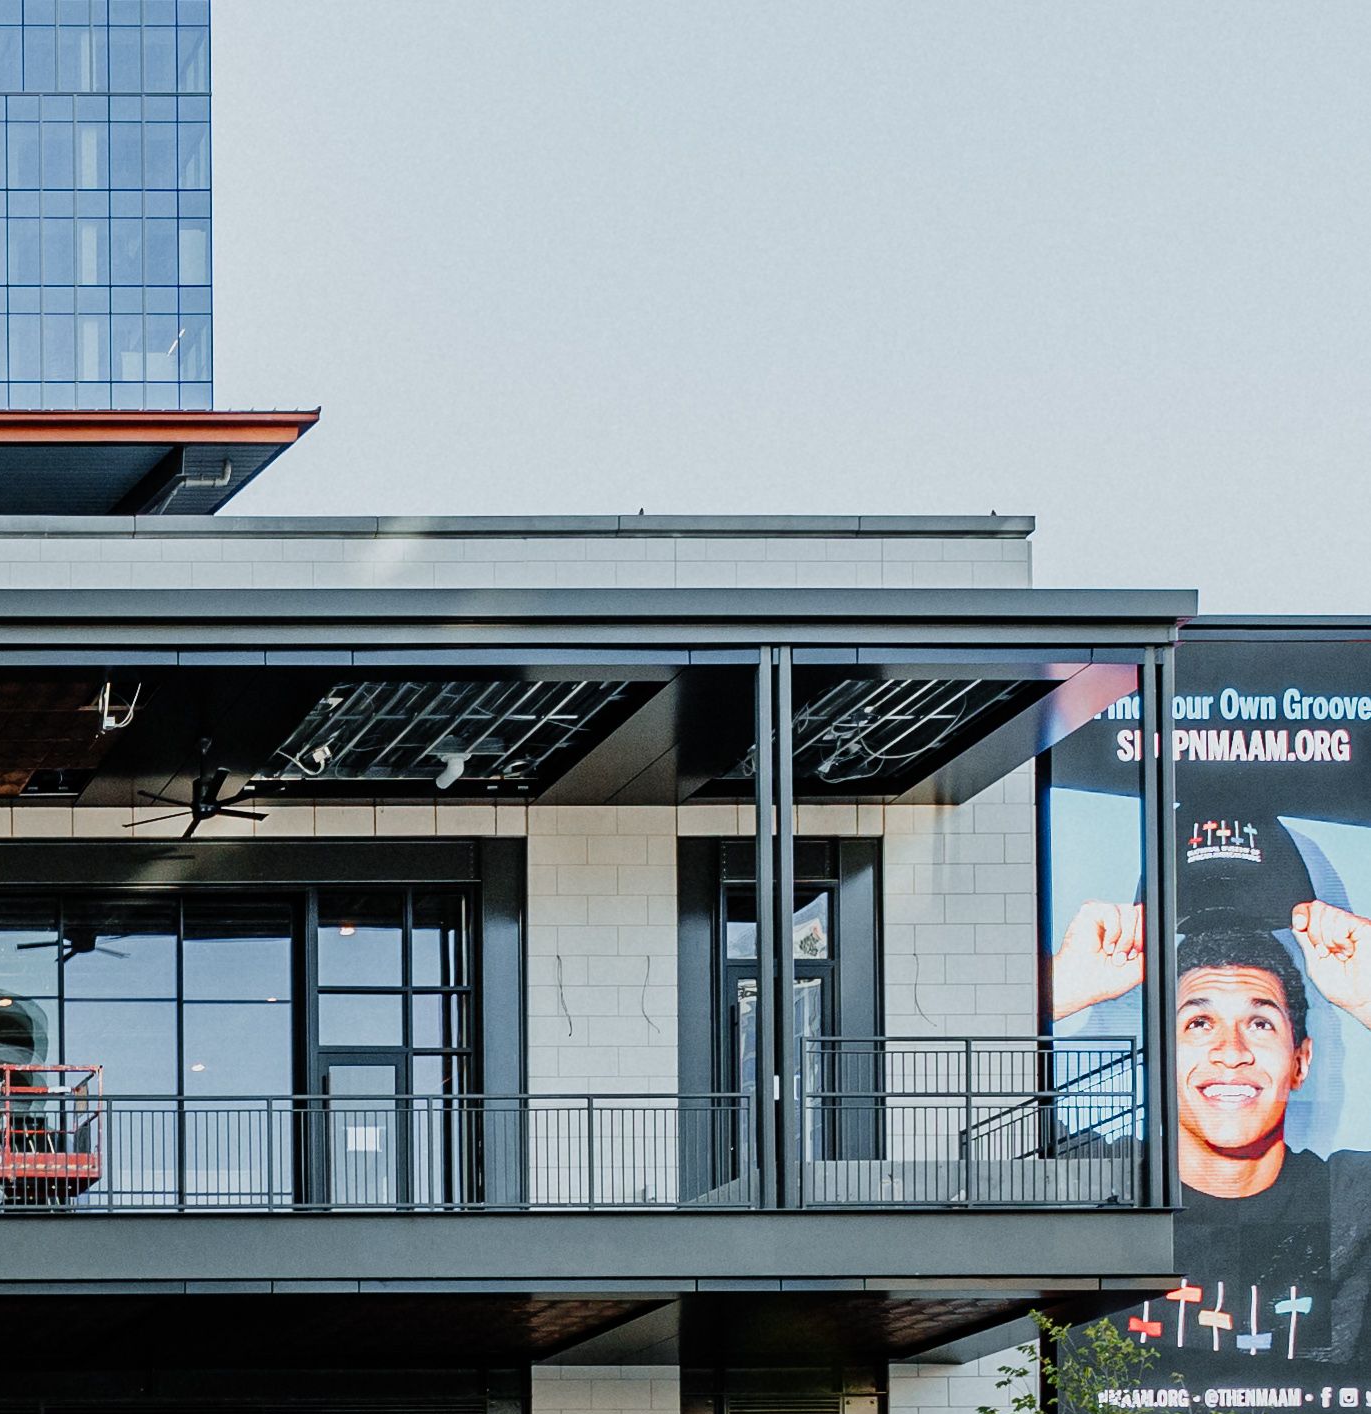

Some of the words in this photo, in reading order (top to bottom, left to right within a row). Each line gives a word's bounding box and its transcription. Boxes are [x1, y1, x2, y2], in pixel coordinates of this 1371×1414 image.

[1171, 694, 1214, 720] our
[1219, 688, 1277, 720] Own
[1282, 688, 1371, 720] Groove
[1116, 729, 1351, 762] SPNMAAM.ORG
[1204, 1387, 1303, 1408] @THENMAAM
